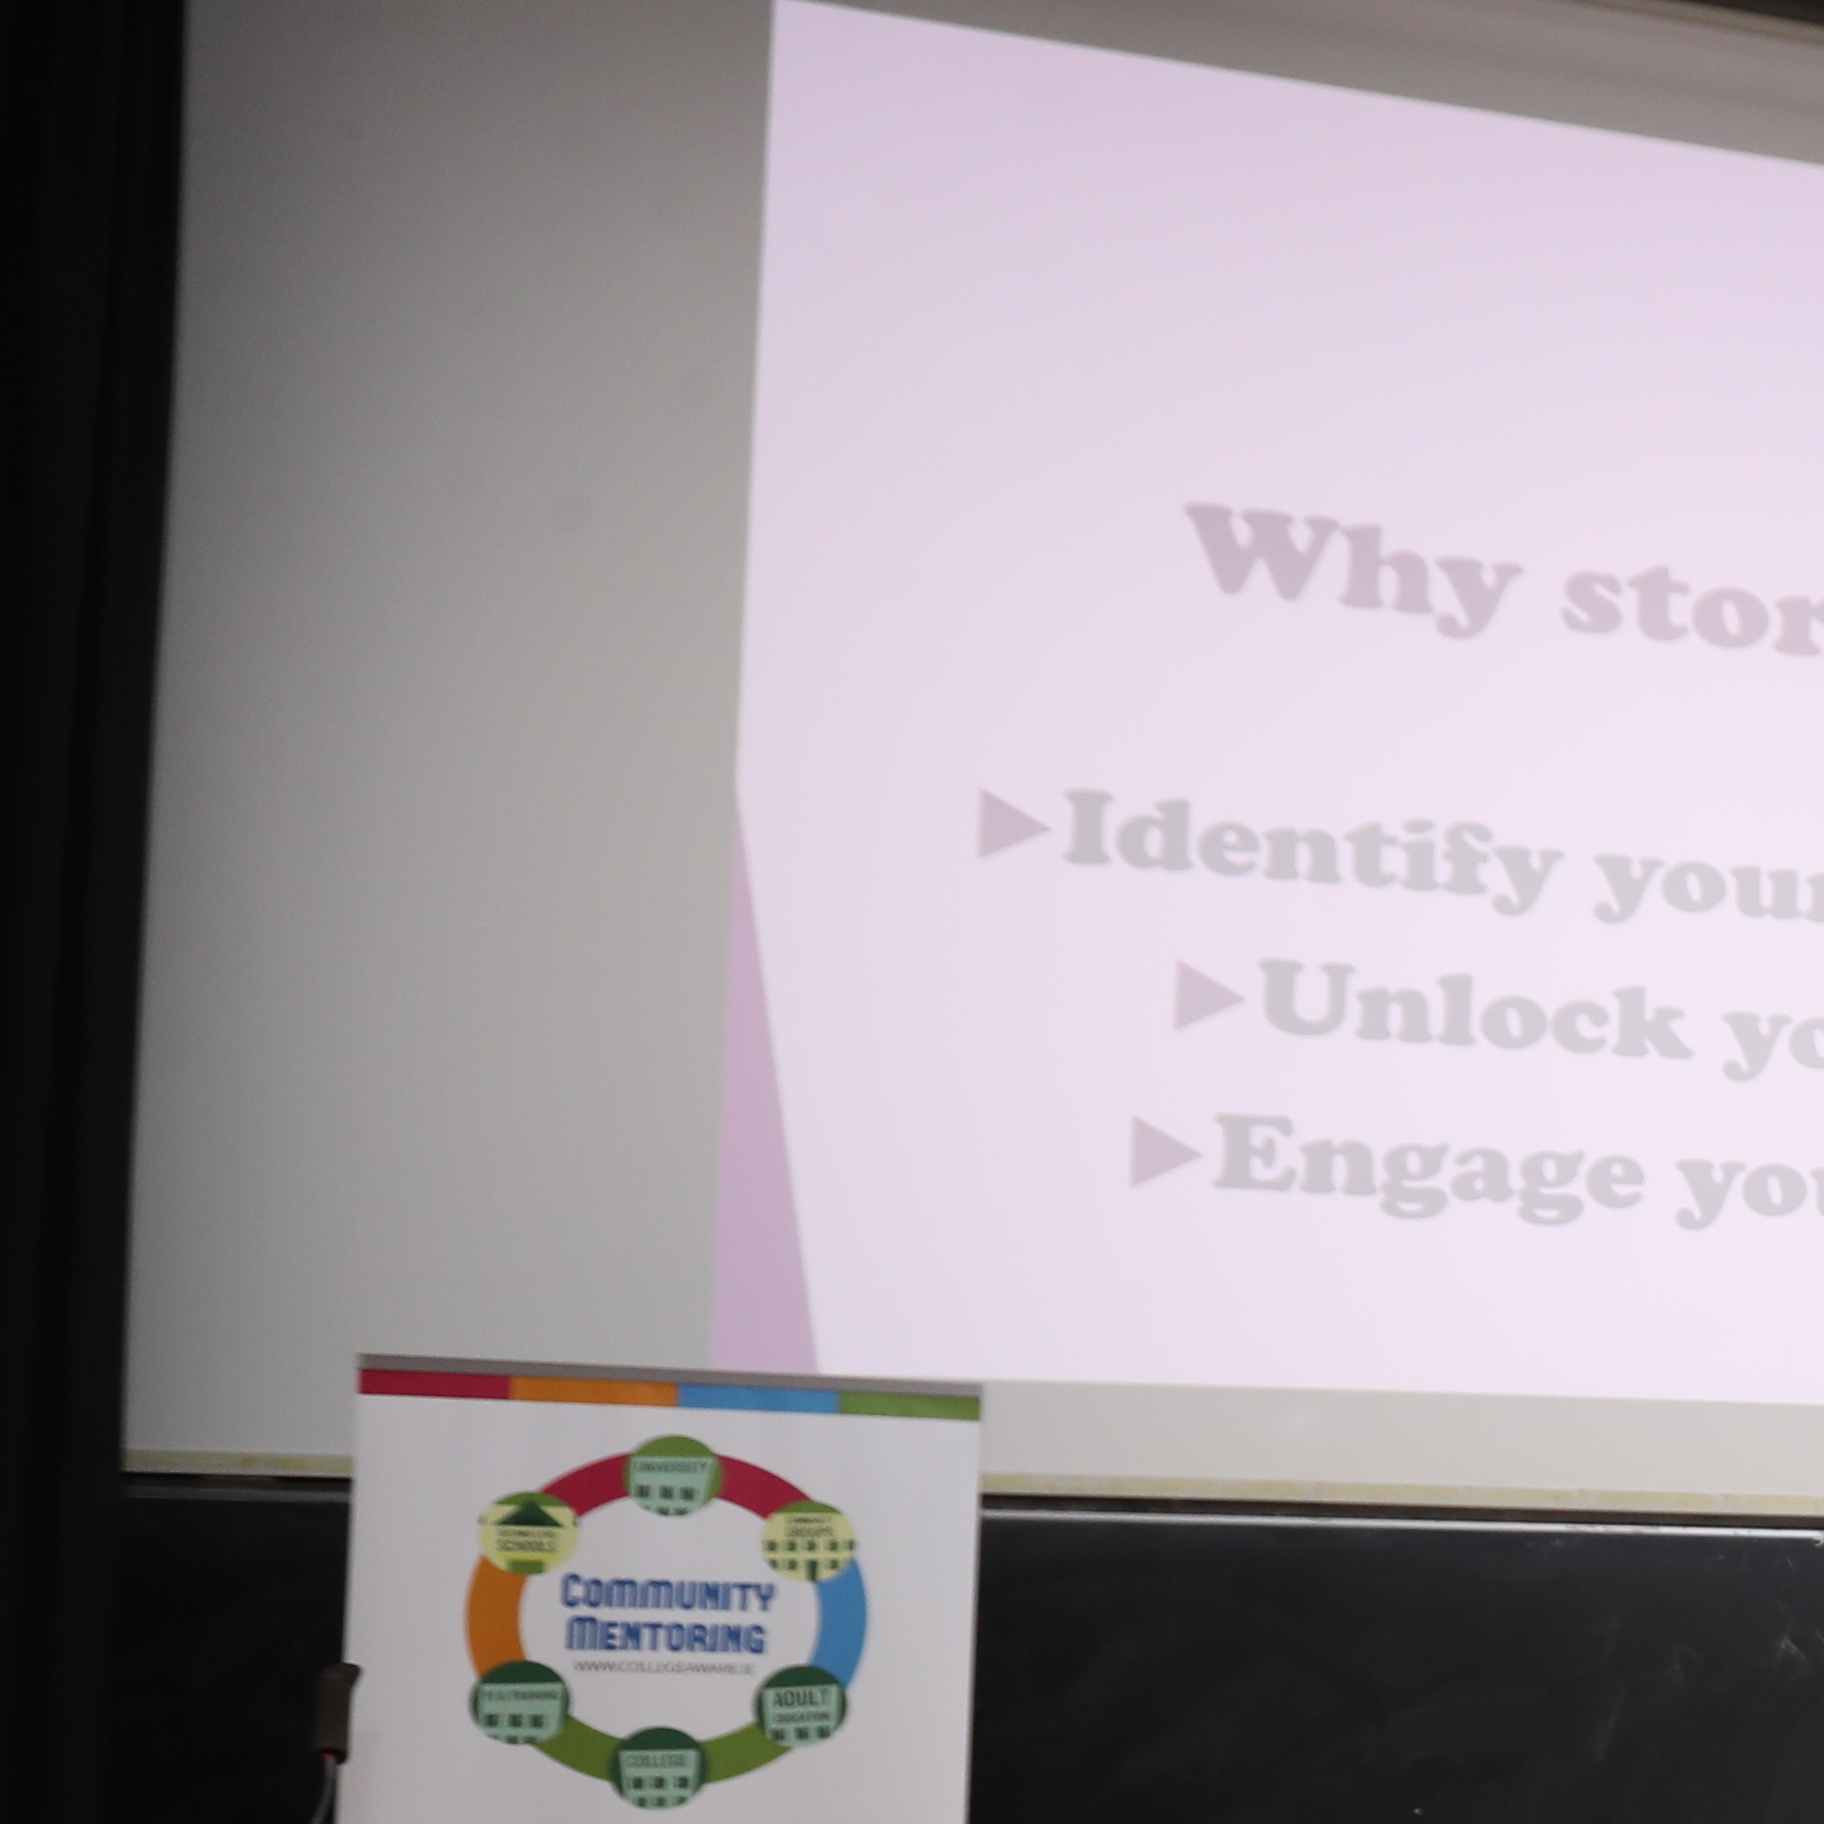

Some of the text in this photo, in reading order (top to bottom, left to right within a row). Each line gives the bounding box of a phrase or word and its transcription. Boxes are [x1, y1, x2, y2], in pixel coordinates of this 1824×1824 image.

[1184, 502, 1523, 640] Why
[1062, 789, 1565, 916] Identify
[1258, 959, 1694, 1060] Unlock
[1212, 1114, 1646, 1226] Engage
[561, 1572, 776, 1611] COMMUNITY
[565, 1615, 767, 1654] MENTORING
[773, 1686, 829, 1707] ADULT
